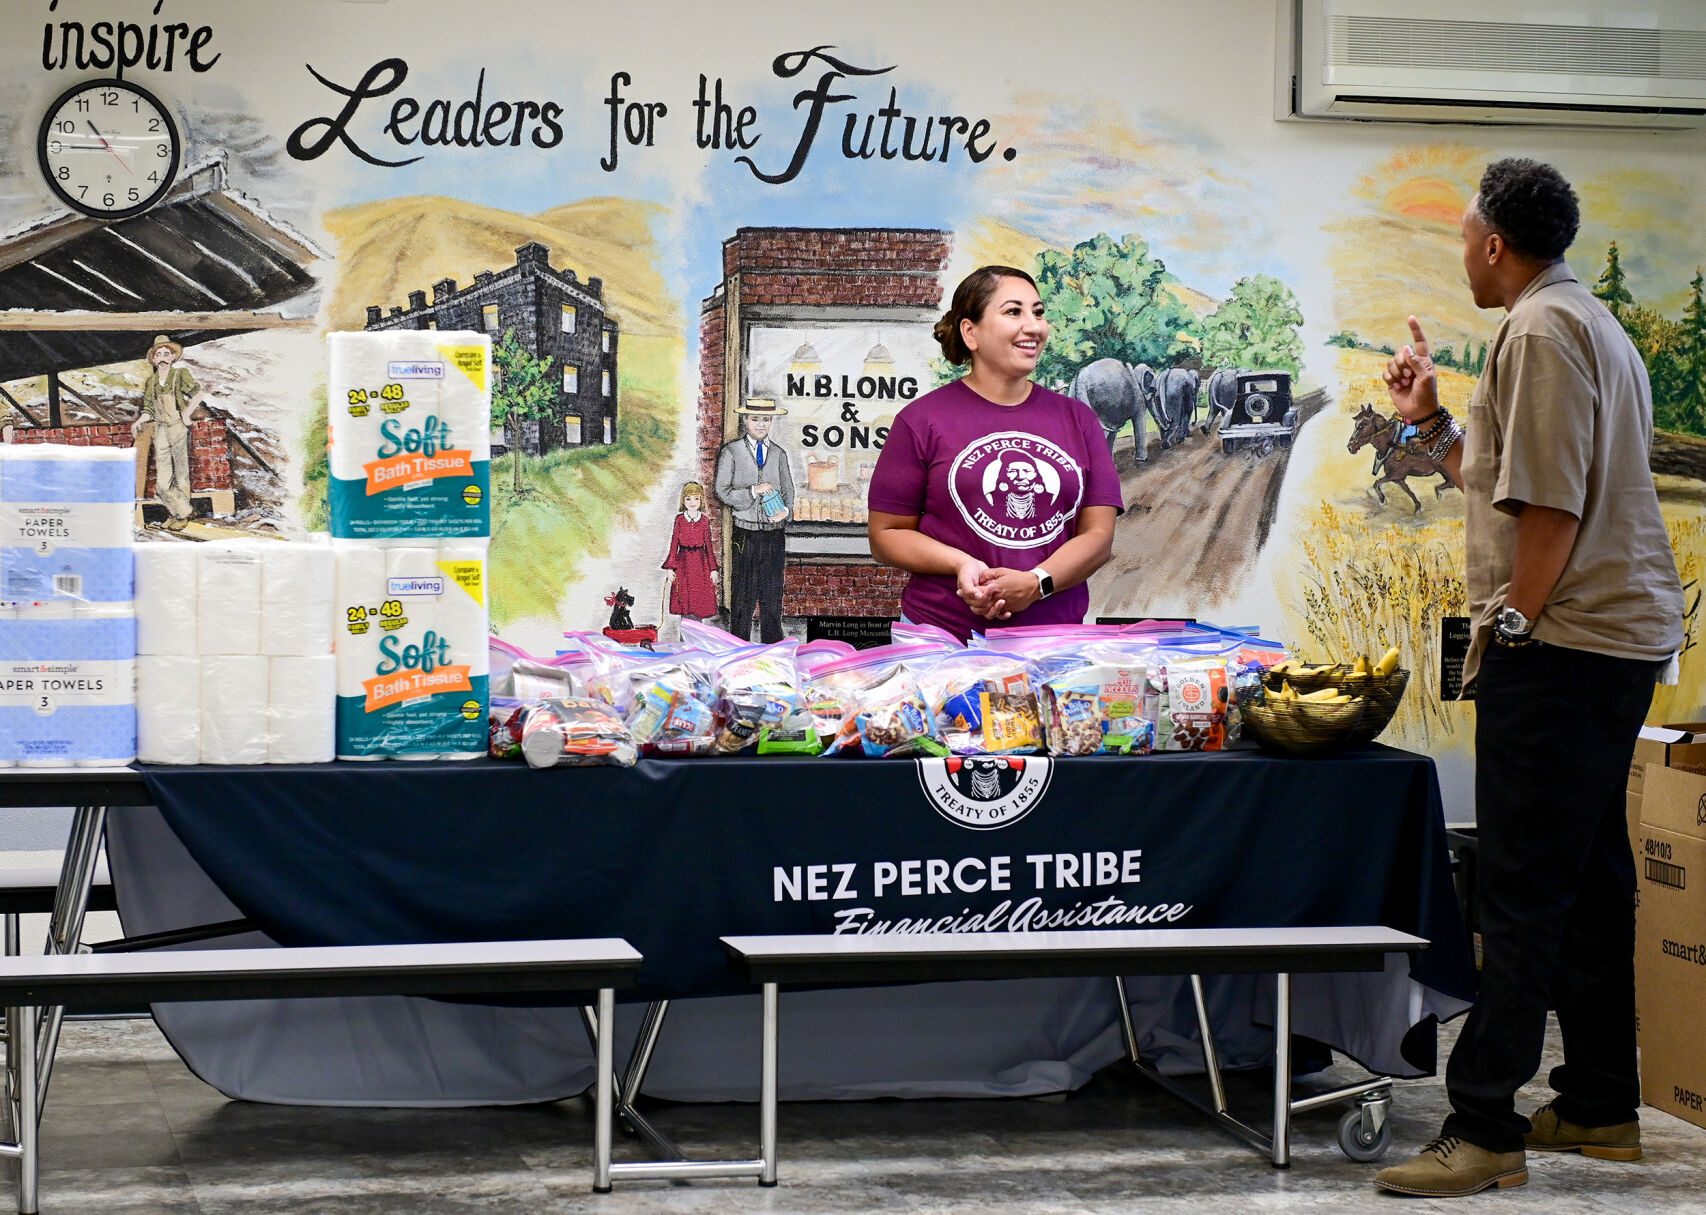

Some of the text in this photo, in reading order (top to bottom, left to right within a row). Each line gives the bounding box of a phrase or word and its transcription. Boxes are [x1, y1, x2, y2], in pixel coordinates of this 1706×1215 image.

[42, 0, 221, 80] inspire
[75, 99, 90, 112] 11
[100, 92, 119, 106] 12
[131, 100, 140, 113] 1
[286, 45, 1017, 184] Leaders for the Future.
[56, 121, 75, 134] 10
[148, 119, 160, 131] 2
[157, 144, 168, 157] 3
[58, 166, 71, 180] 8
[147, 170, 159, 184] 4
[77, 185, 89, 199] 7
[127, 188, 139, 201] 5
[103, 193, 115, 207] 6
[391, 364, 441, 376] trueliving
[348, 389, 367, 404] 24
[381, 384, 403, 400] 48
[840, 402, 861, 423] &
[377, 415, 454, 459] Soft
[801, 424, 891, 450] SONS
[962, 439, 1075, 472] NEZ PERCE TRIBE
[374, 456, 465, 483] Bath Tissue
[25, 518, 63, 527] PAPER
[973, 507, 1064, 539] TREATY OF 1855
[19, 528, 70, 537] TOWELS
[41, 541, 48, 550] 3
[391, 581, 440, 592] trueliving
[347, 606, 367, 622] 24
[380, 600, 403, 617] 48
[842, 621, 859, 630] Long
[842, 629, 859, 637] Long
[376, 631, 452, 676] Soft
[41, 680, 103, 690] TOWELS
[373, 672, 464, 700] Bath Tissue
[1177, 677, 1206, 689] GOLDEN
[41, 696, 48, 707] 3
[1178, 700, 1206, 712] ISLAND
[935, 778, 1039, 819] TREATY OF 1855
[1645, 838, 1672, 860] 48/10/3
[773, 849, 1142, 901] NEZ PERCE TRIBE
[833, 895, 1194, 935] Financial Assistance
[1662, 938, 1706, 966] smart&
[1674, 1085, 1703, 1113] PAPER
